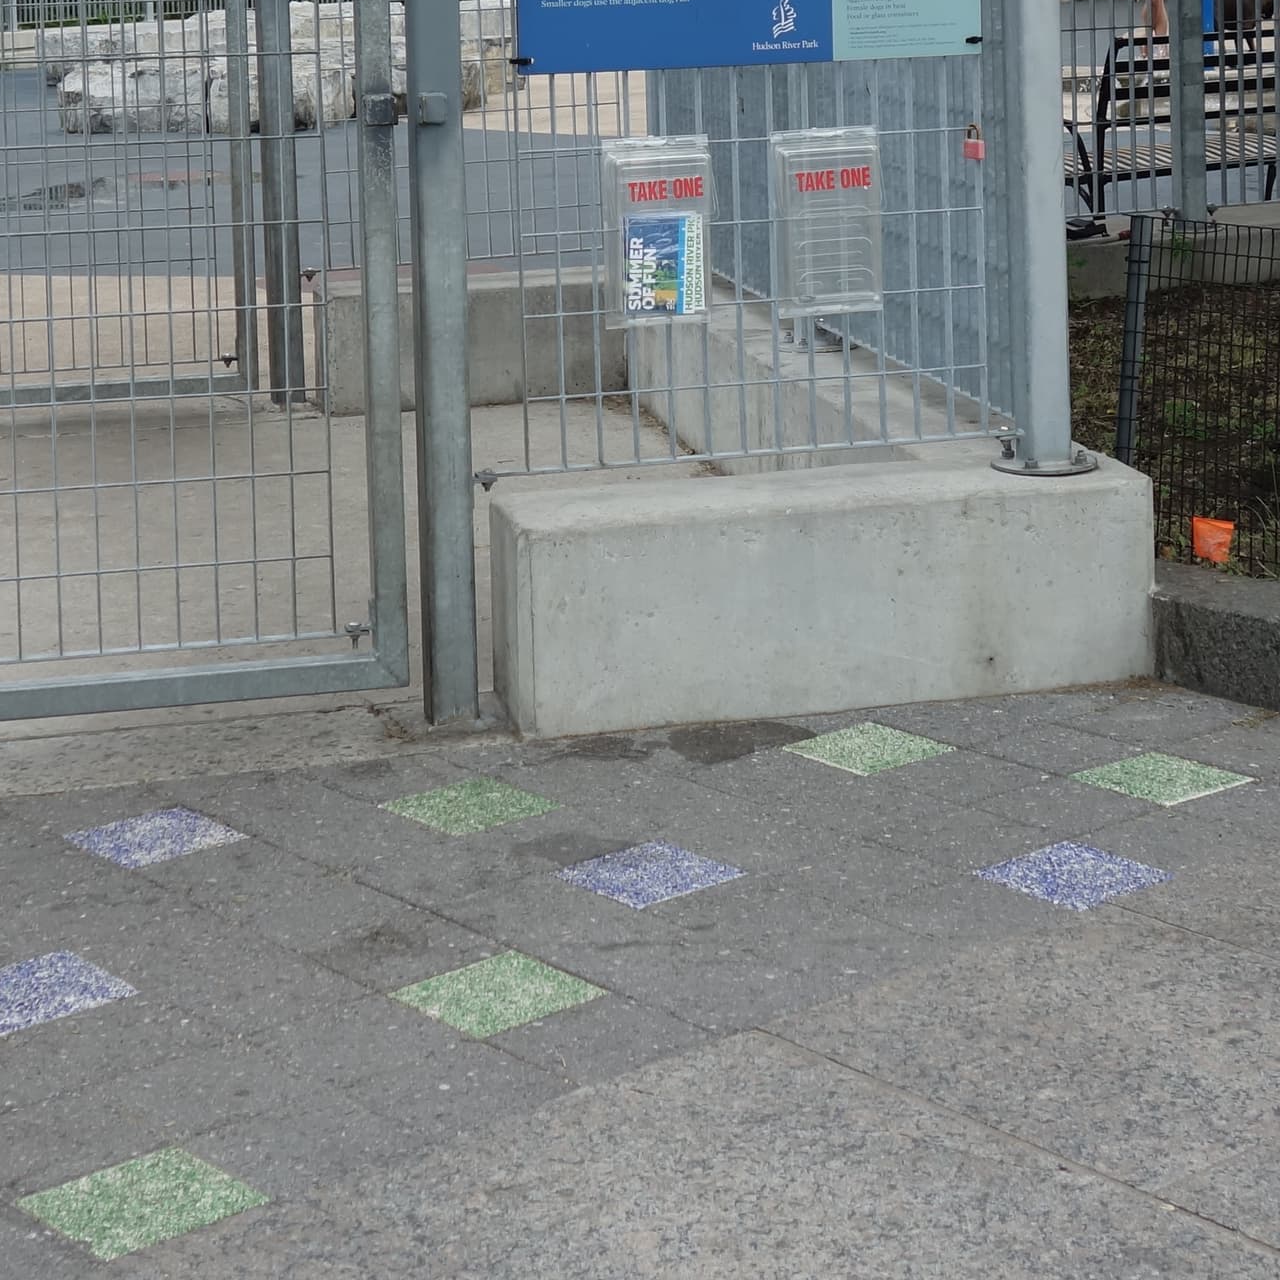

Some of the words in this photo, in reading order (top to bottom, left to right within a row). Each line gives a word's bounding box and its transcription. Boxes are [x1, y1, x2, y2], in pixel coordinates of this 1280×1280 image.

[541, 0, 571, 8] Smaller
[752, 41, 781, 51] Hudson
[782, 40, 800, 50] River
[802, 40, 819, 48] Park
[628, 180, 667, 202] TAKE
[672, 177, 704, 199] ONE
[796, 170, 836, 193] TAKE
[841, 166, 871, 188] ONE
[686, 235, 694, 265] RIVER
[629, 238, 643, 310] SUMMER
[643, 248, 656, 283] FUN
[642, 288, 656, 310] OF
[685, 268, 693, 310] HUDSON
